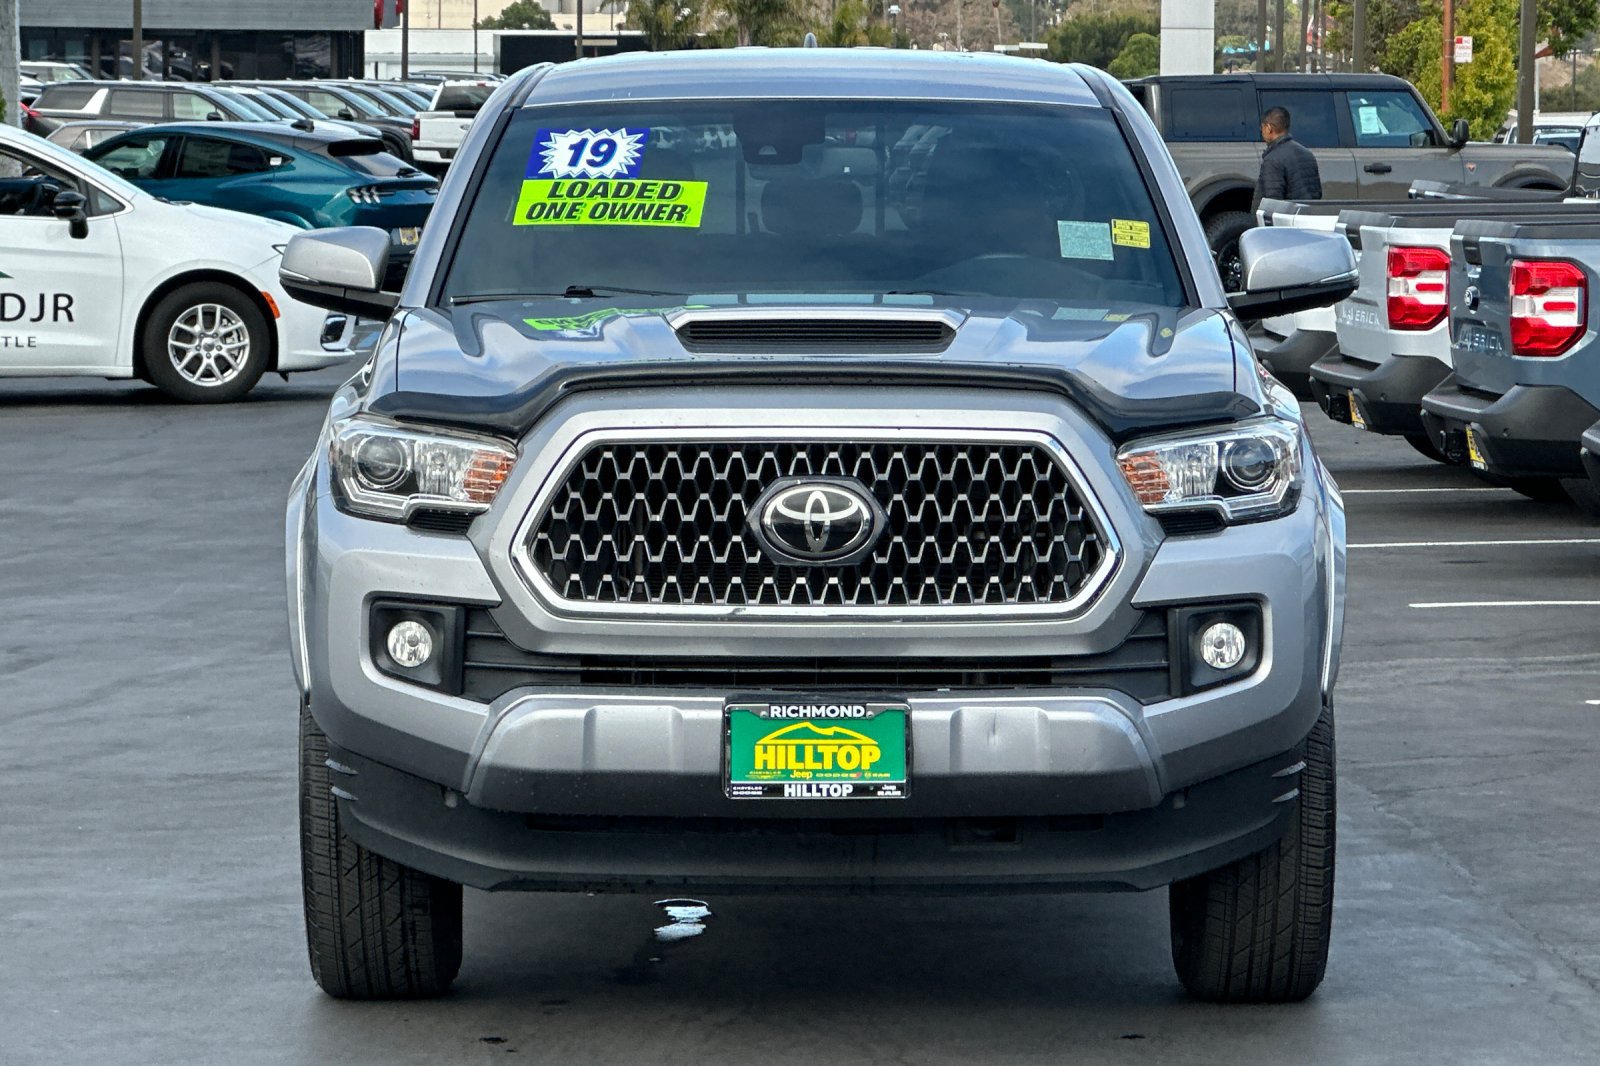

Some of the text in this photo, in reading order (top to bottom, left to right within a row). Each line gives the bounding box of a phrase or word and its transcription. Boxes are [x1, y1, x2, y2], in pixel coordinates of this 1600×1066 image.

[568, 138, 618, 168] 19
[547, 181, 684, 200] LOADED
[525, 202, 691, 223] ONE OWNER
[0, 292, 75, 323] DJR
[0, 336, 37, 348] TLE
[770, 705, 866, 718] RICHMOND
[754, 745, 881, 770] HILLTOP
[790, 769, 813, 780] Jeep
[783, 783, 853, 797] HILLTOP
